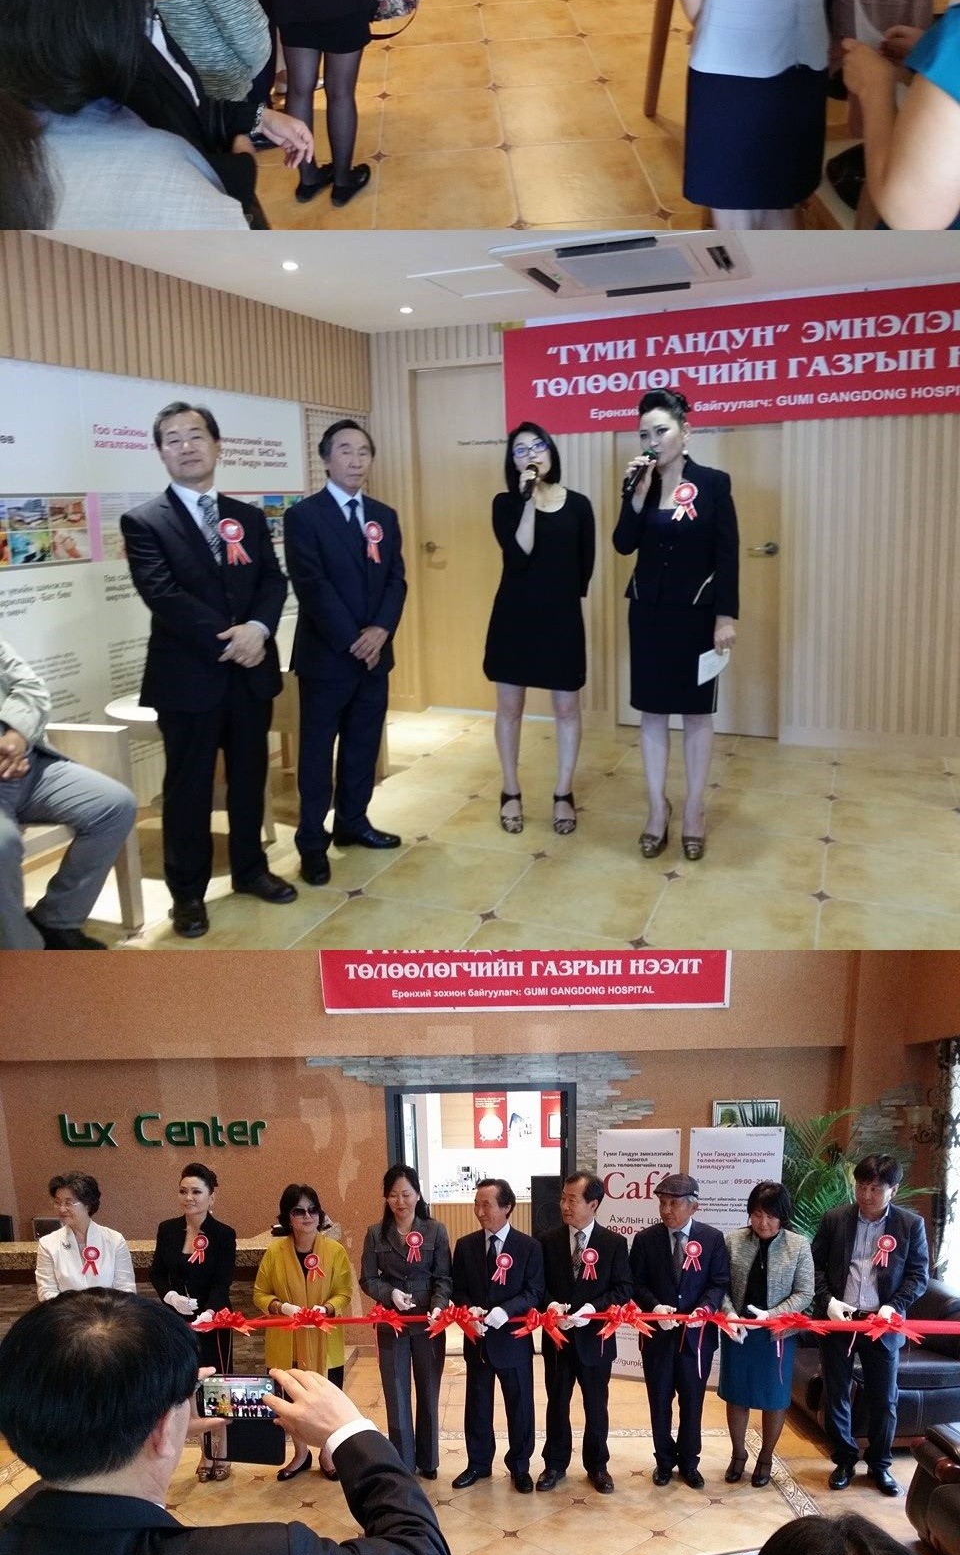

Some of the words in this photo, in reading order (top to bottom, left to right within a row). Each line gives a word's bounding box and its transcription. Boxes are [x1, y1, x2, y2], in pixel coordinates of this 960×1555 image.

[531, 357, 777, 399] ТӨЛӨӨЛӨГЧИЙН
[787, 347, 936, 379] ГАЗРЫН
[694, 397, 772, 413] байгуулагч:
[776, 393, 814, 407] GUMI
[817, 388, 907, 403] GANGDONG
[344, 958, 524, 980] ТӨЛӨӨЛӨГЧИЙН
[530, 959, 622, 977] ГАЗРЫН
[629, 958, 703, 975] НЭЭЛТ
[392, 989, 432, 1000] Ерөнхий
[433, 989, 466, 998] зохион
[468, 988, 521, 999] байгуулагч:
[523, 986, 549, 996] GUMI
[550, 986, 606, 995] GANGDONG
[607, 985, 655, 994] HOSPITAL
[57, 1112, 119, 1147] Lux
[133, 1112, 268, 1147] Center
[609, 1214, 644, 1224] Ажлын
